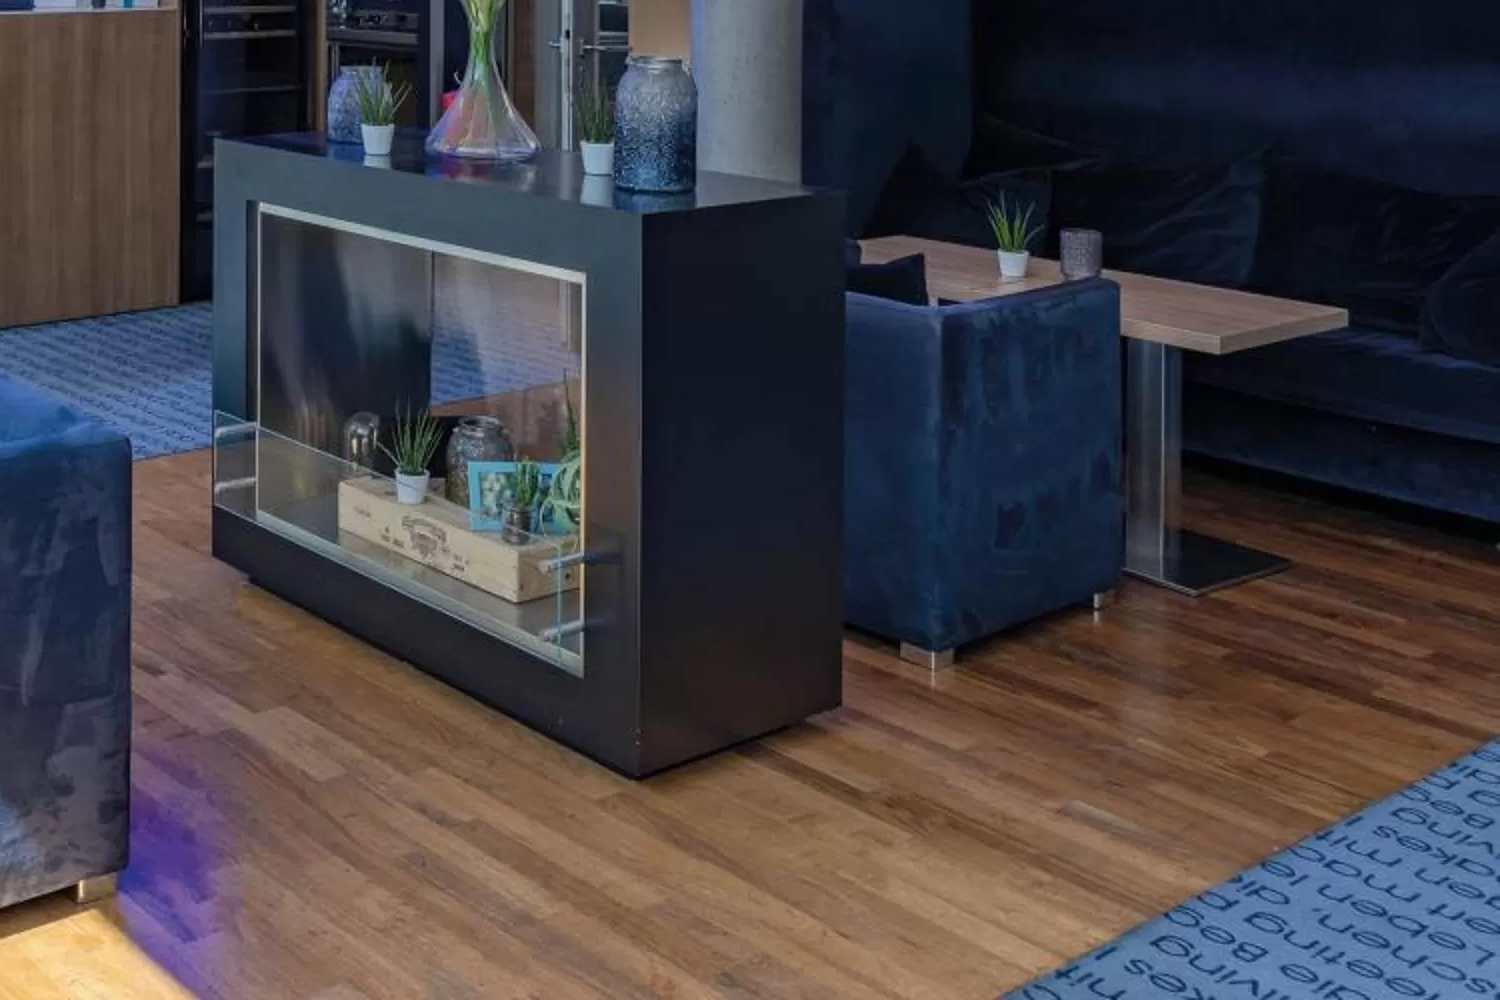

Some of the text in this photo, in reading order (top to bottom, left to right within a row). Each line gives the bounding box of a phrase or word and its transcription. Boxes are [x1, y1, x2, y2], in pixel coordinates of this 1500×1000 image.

[1243, 911, 1440, 1000] eeting
[1311, 907, 1500, 1000] schen,
[1317, 883, 1496, 966] Leben
